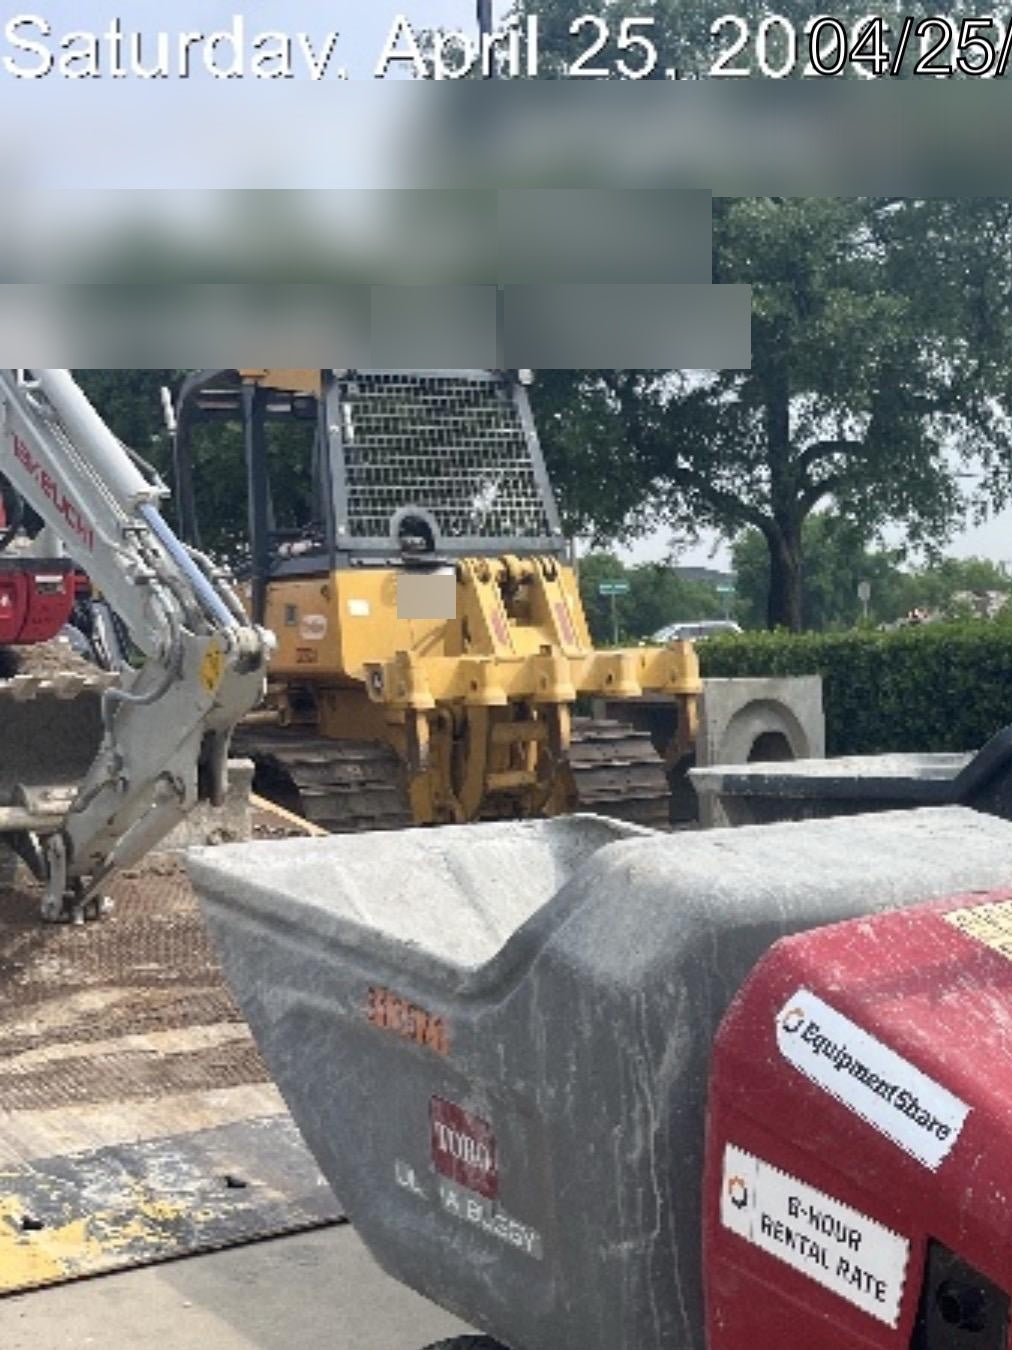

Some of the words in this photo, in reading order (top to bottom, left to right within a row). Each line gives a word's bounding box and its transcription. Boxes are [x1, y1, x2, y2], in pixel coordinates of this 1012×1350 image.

[800, 1021, 952, 1141] EquipmentShare
[760, 1212, 830, 1270] RENTAL
[836, 1256, 888, 1303] RATE
